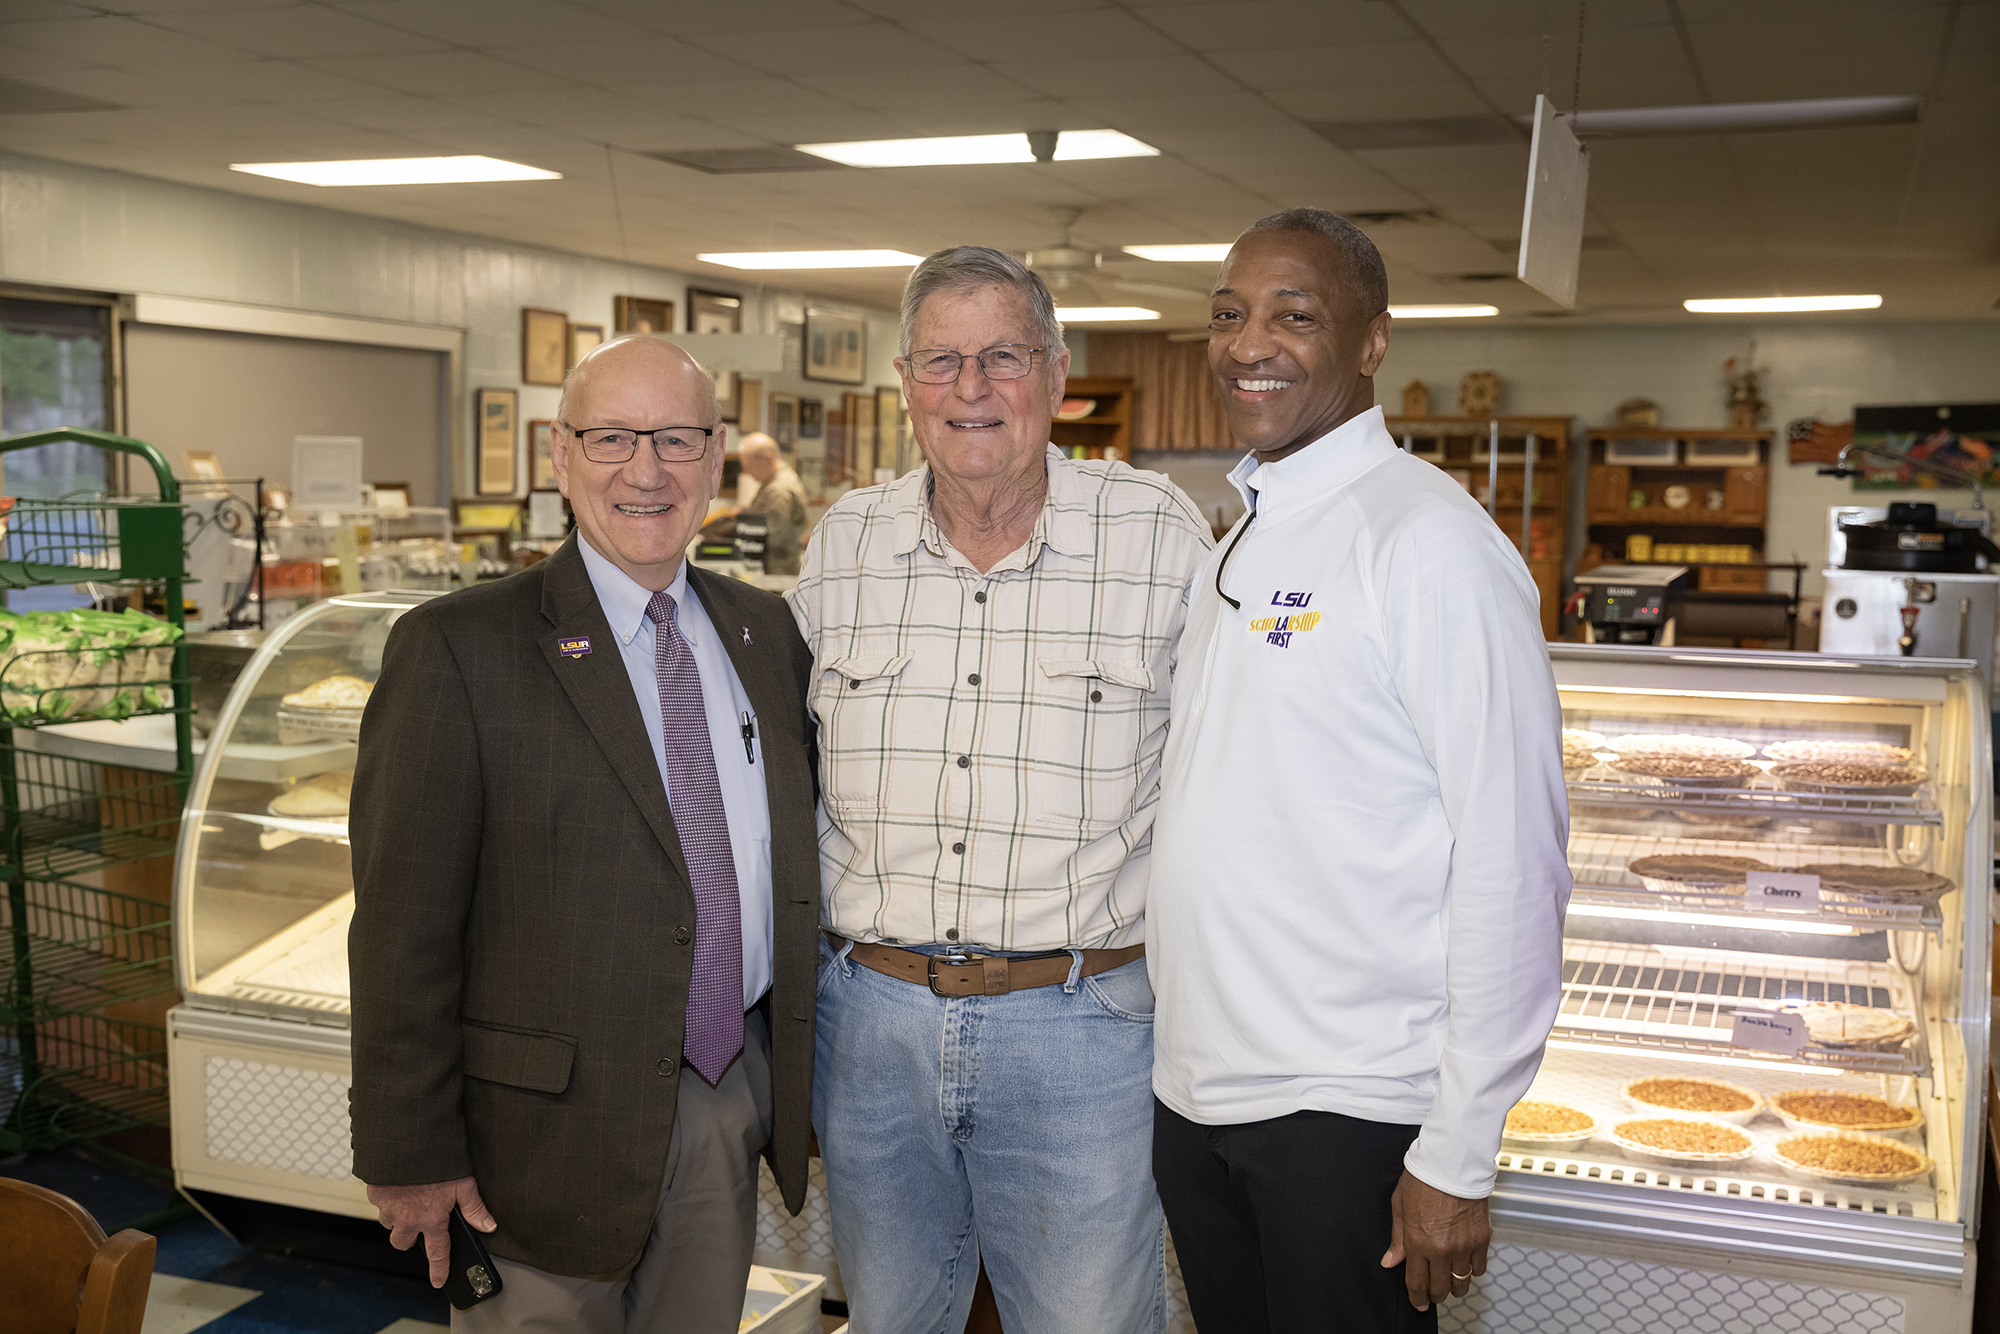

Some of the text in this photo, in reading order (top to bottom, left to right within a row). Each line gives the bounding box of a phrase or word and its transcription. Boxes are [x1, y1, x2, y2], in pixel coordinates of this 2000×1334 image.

[1271, 590, 1313, 608] LSU
[1249, 611, 1321, 632] SCHOLARSHIP
[1266, 632, 1293, 649] FIRST
[1764, 886, 1801, 900] Cherry
